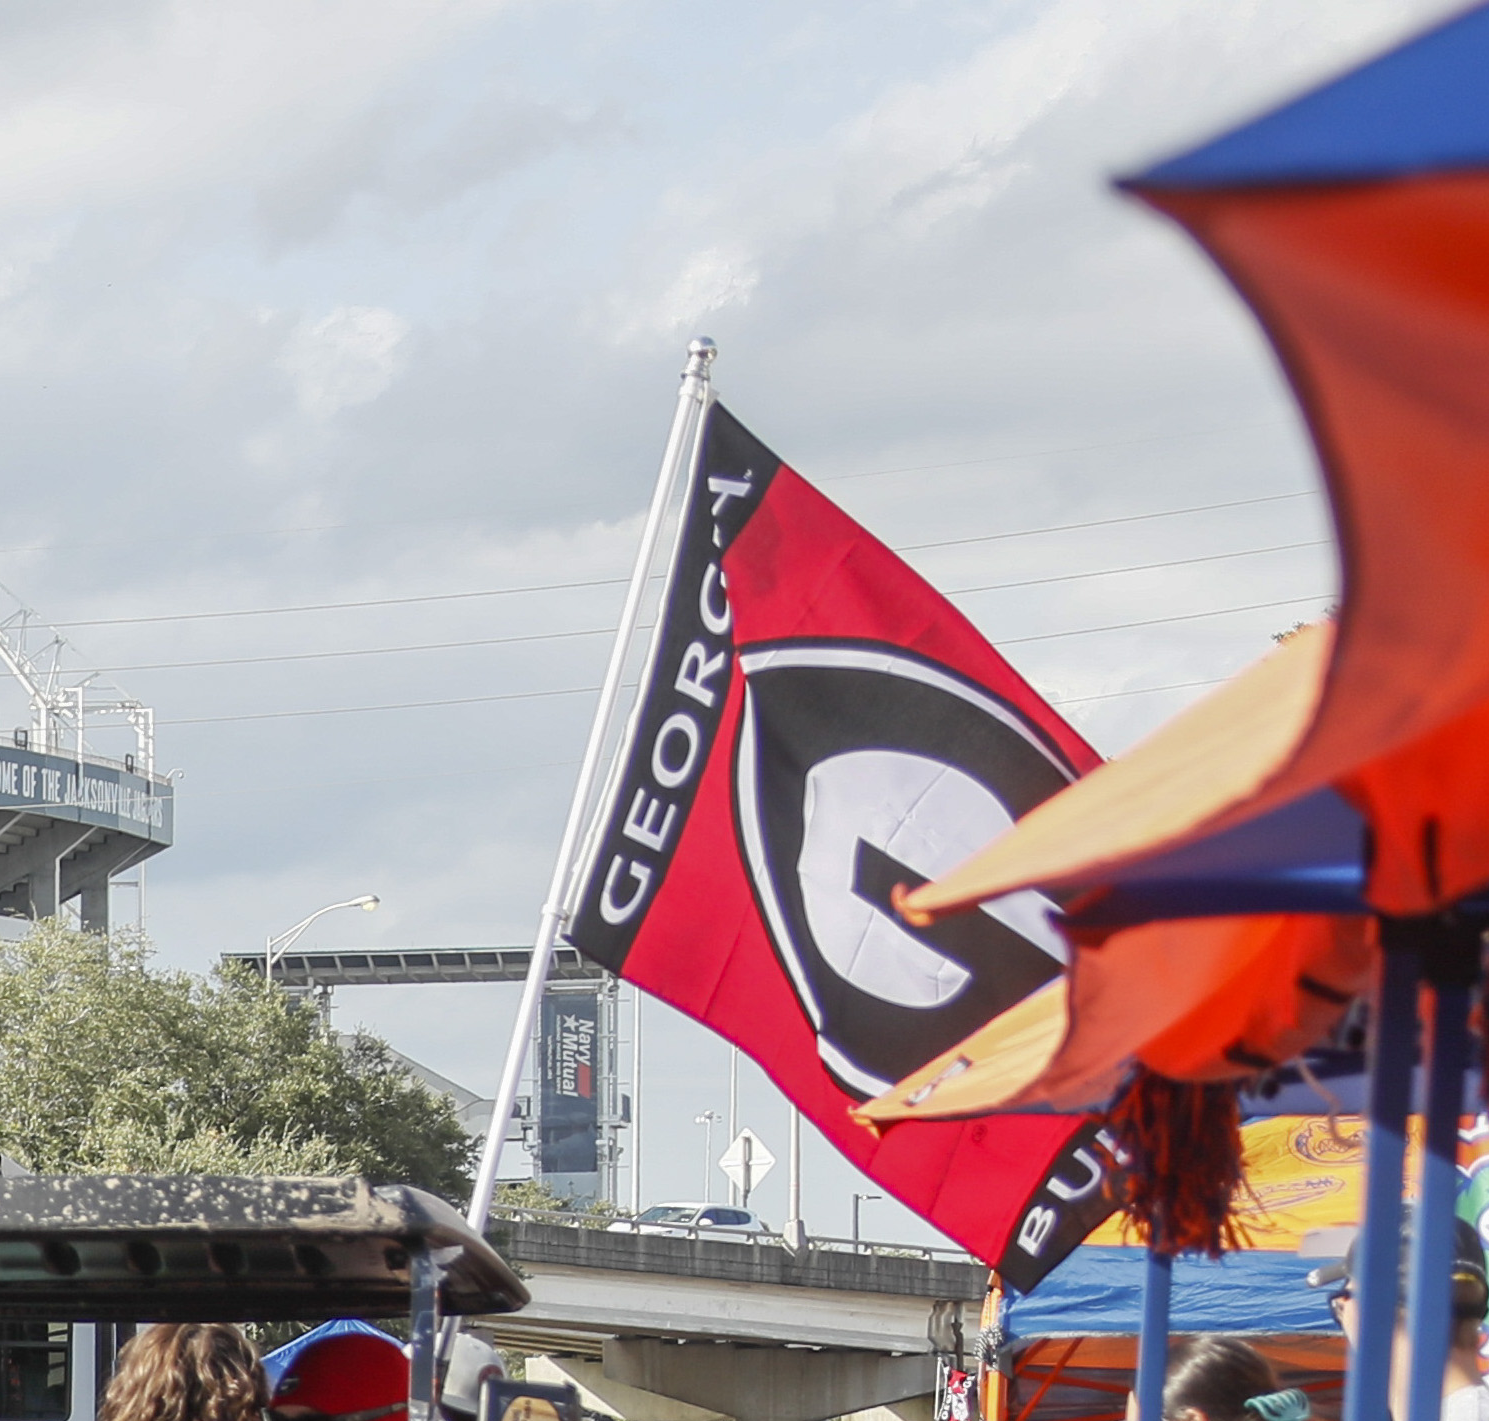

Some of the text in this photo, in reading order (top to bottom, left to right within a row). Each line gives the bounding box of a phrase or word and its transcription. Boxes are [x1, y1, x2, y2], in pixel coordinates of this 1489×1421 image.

[598, 475, 753, 926] GEORGA
[22, 764, 38, 799] OF
[41, 767, 61, 803] THE
[562, 1032, 579, 1098] Mutual
[575, 1018, 595, 1067] Navy
